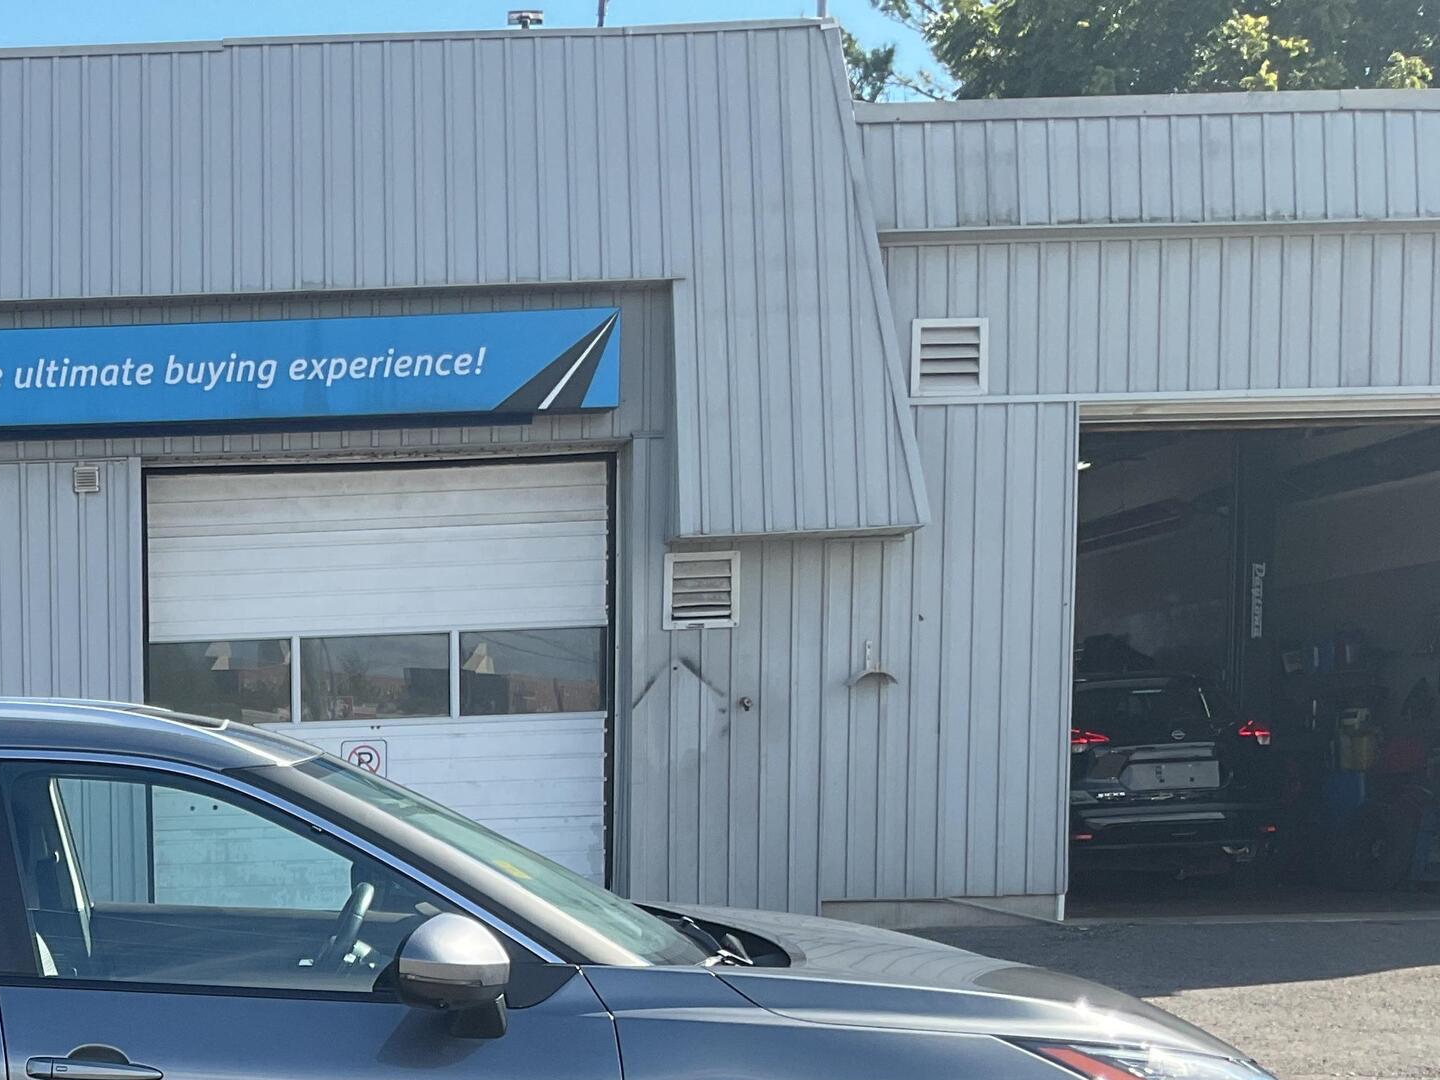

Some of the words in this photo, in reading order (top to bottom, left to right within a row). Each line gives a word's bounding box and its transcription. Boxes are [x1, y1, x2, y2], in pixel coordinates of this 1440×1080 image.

[14, 357, 154, 389] ultimate
[165, 352, 277, 391] buying
[288, 347, 486, 387] experience!
